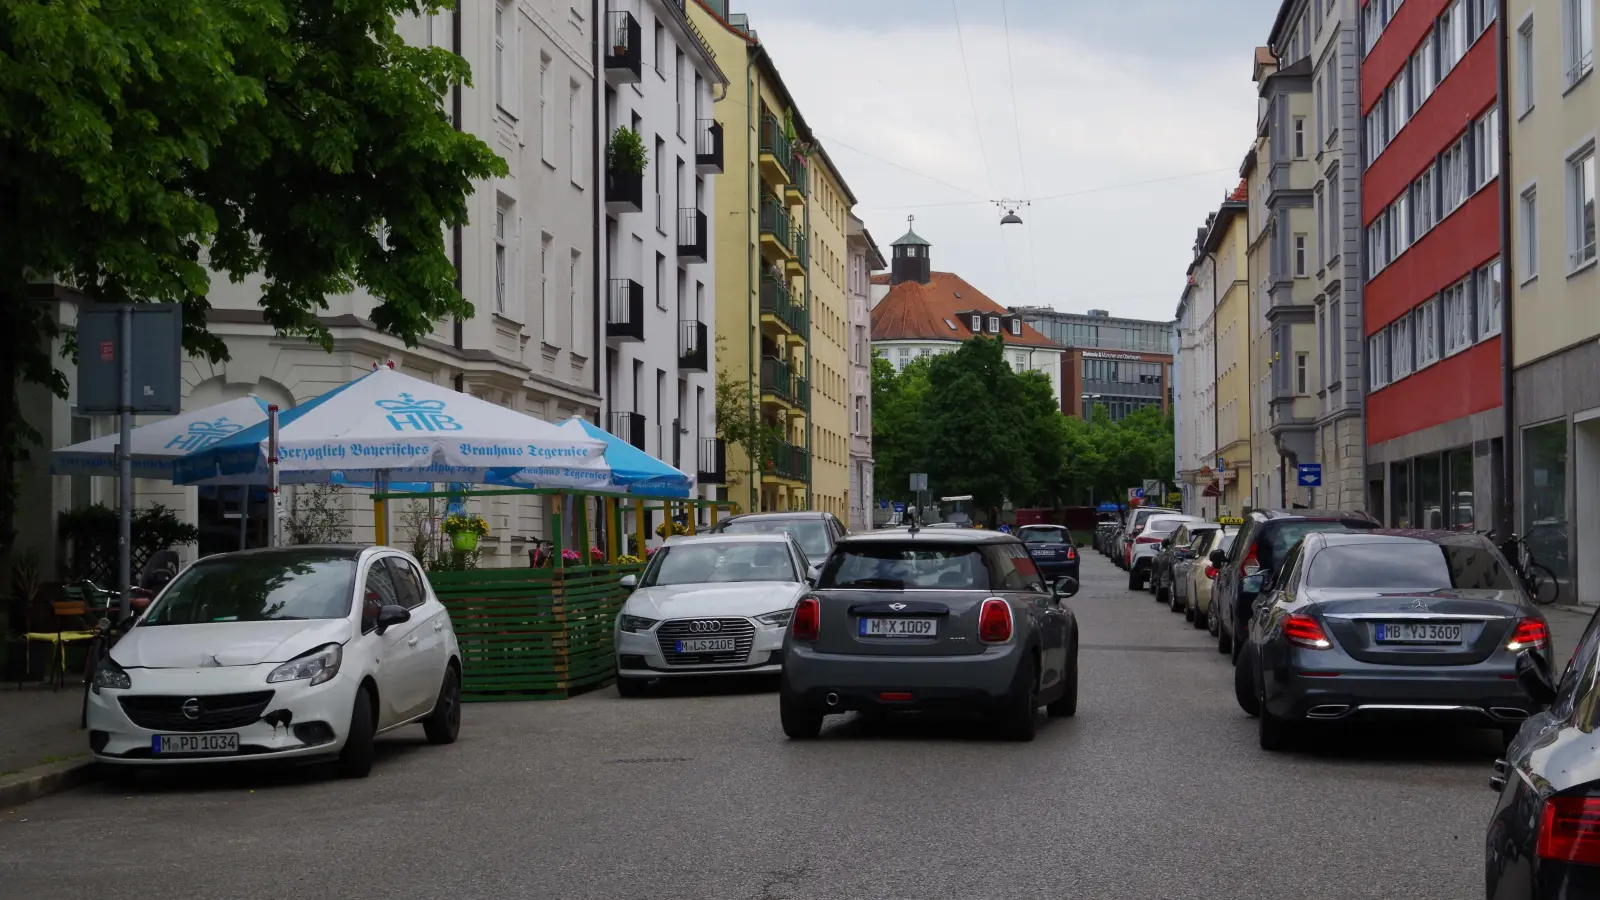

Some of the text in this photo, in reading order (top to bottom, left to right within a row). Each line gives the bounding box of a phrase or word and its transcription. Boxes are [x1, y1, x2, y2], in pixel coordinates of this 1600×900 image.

[386, 411, 463, 431] HTB
[459, 443, 524, 458] Brauhaus
[871, 620, 931, 634] M X 1009
[1385, 625, 1460, 640] MB YJ 3609
[681, 639, 734, 652] M LS 210E
[162, 735, 236, 751] M PD 1034
